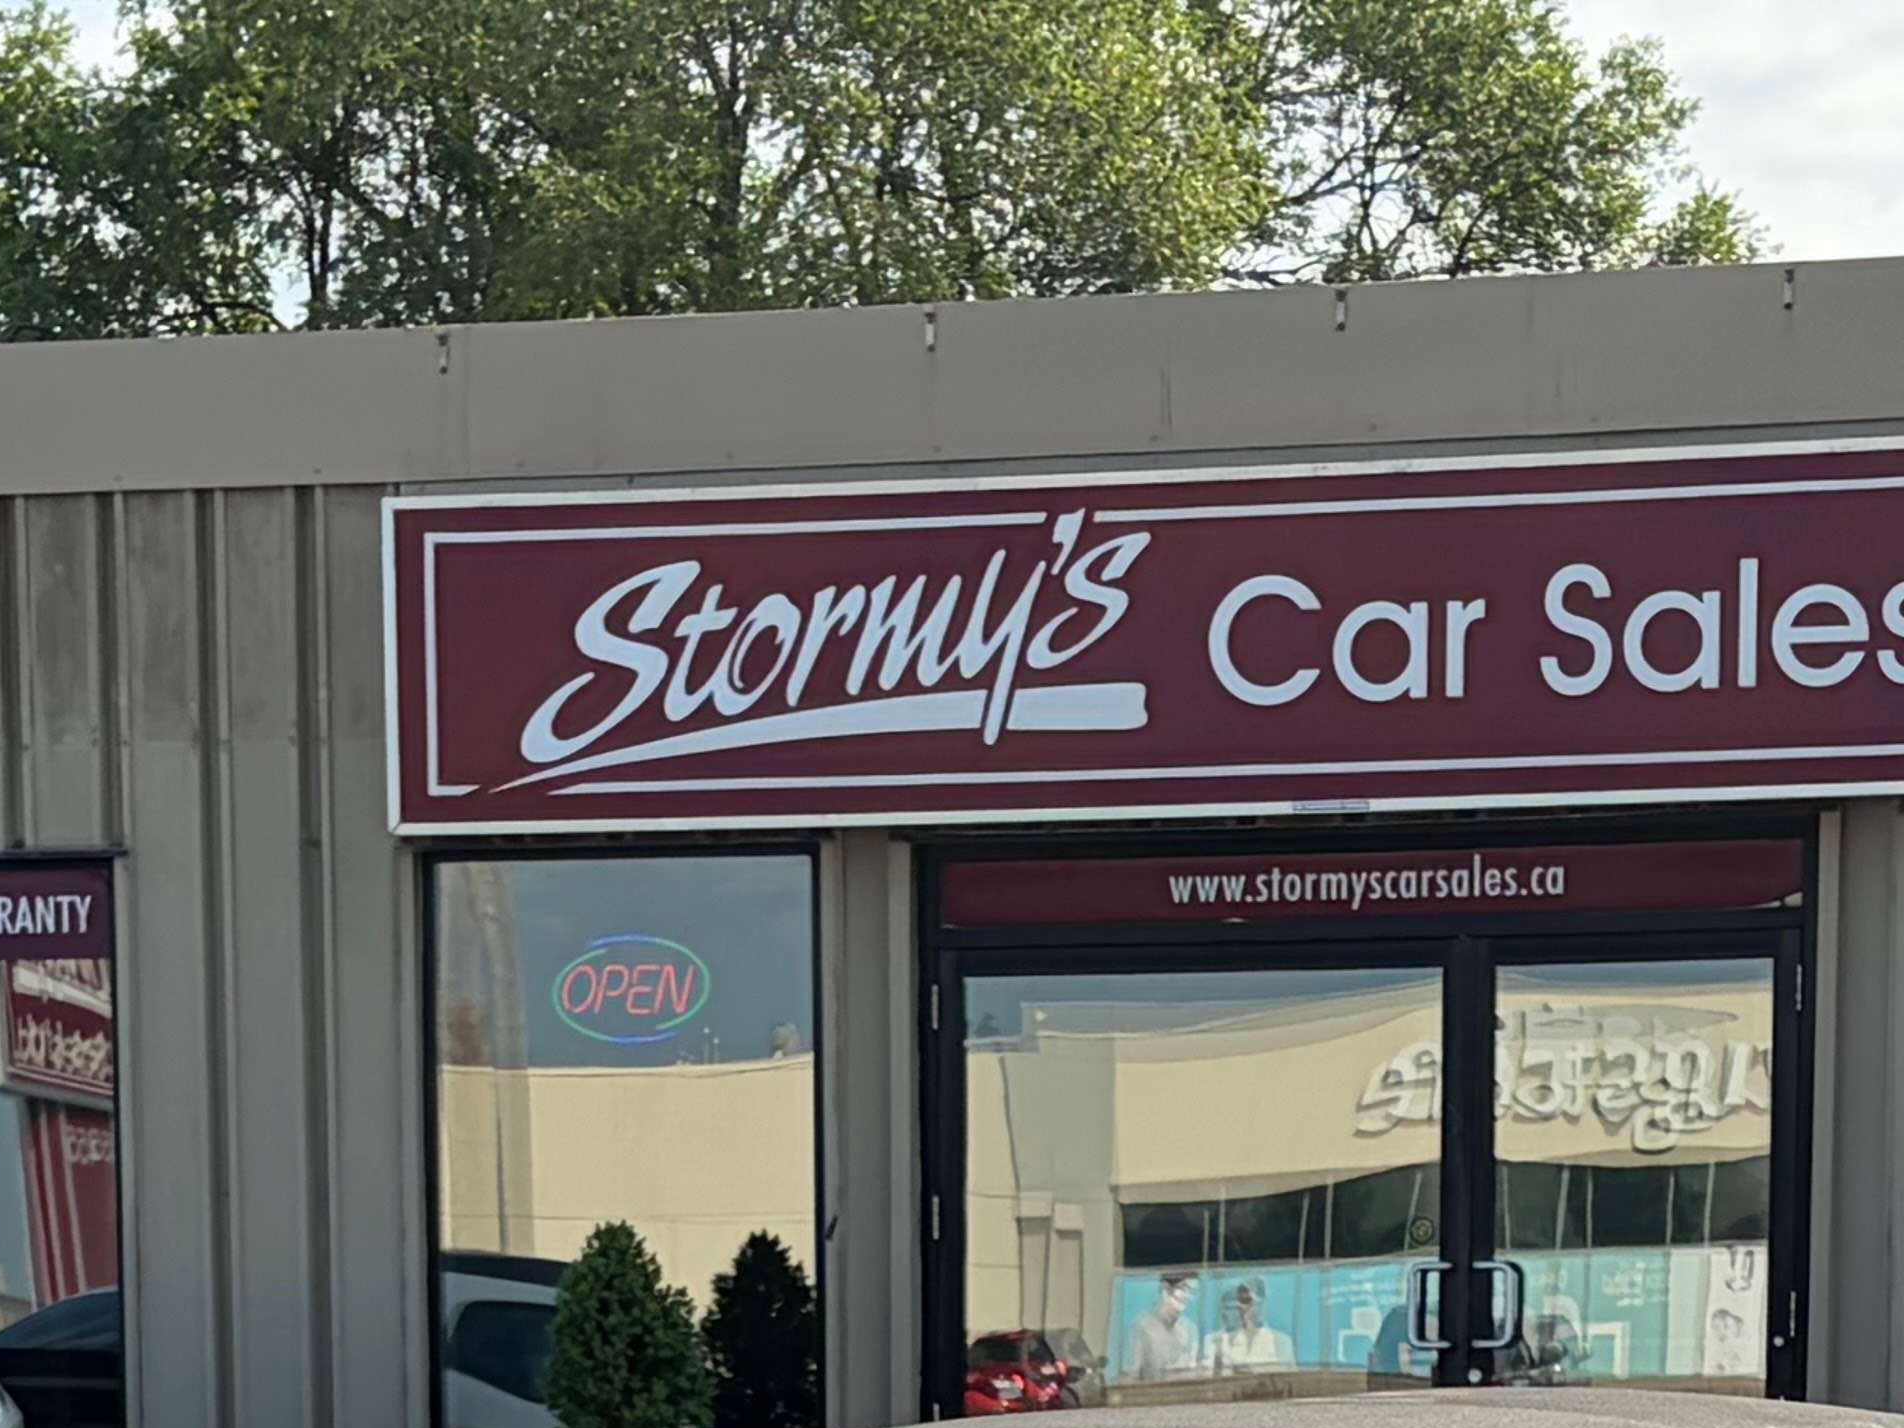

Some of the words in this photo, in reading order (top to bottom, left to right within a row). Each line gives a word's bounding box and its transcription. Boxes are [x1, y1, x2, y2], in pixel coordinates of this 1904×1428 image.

[520, 508, 1151, 763] Stormy's
[1207, 574, 1485, 707] Car
[1169, 855, 1566, 911] www.stormyscarsales.ca
[561, 963, 696, 1014] OPEN
